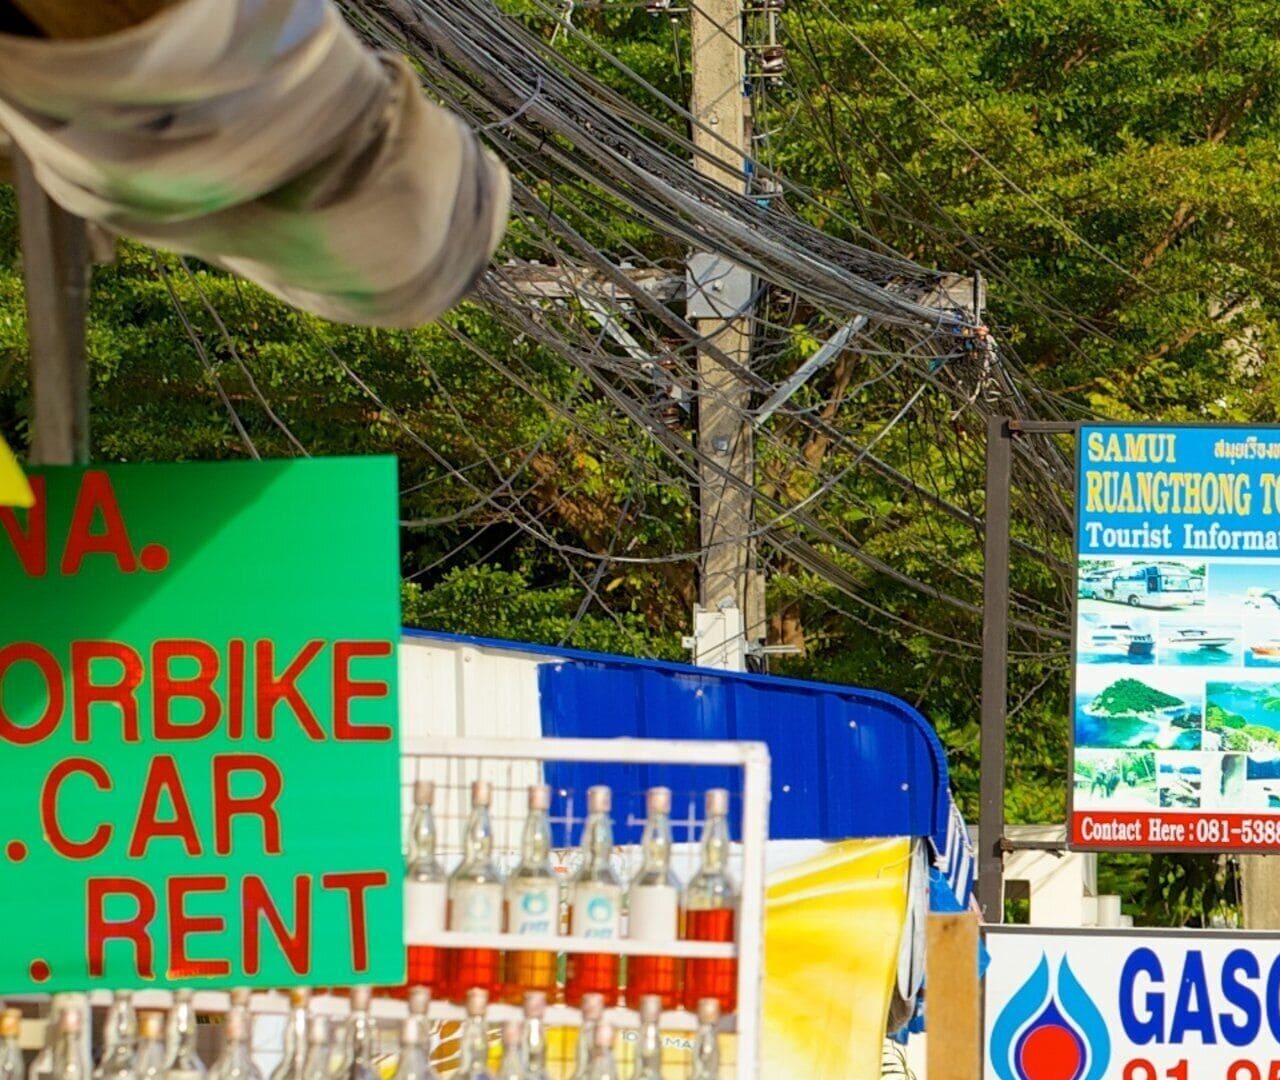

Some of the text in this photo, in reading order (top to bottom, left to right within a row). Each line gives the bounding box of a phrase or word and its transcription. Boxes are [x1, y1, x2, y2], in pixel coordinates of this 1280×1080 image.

[1087, 432, 1177, 463] SAMUI
[1085, 471, 1252, 515] RUANGTHONG
[1085, 522, 1172, 549] Tourist
[0, 639, 394, 744] ORBIKE
[1081, 817, 1142, 841] Contact
